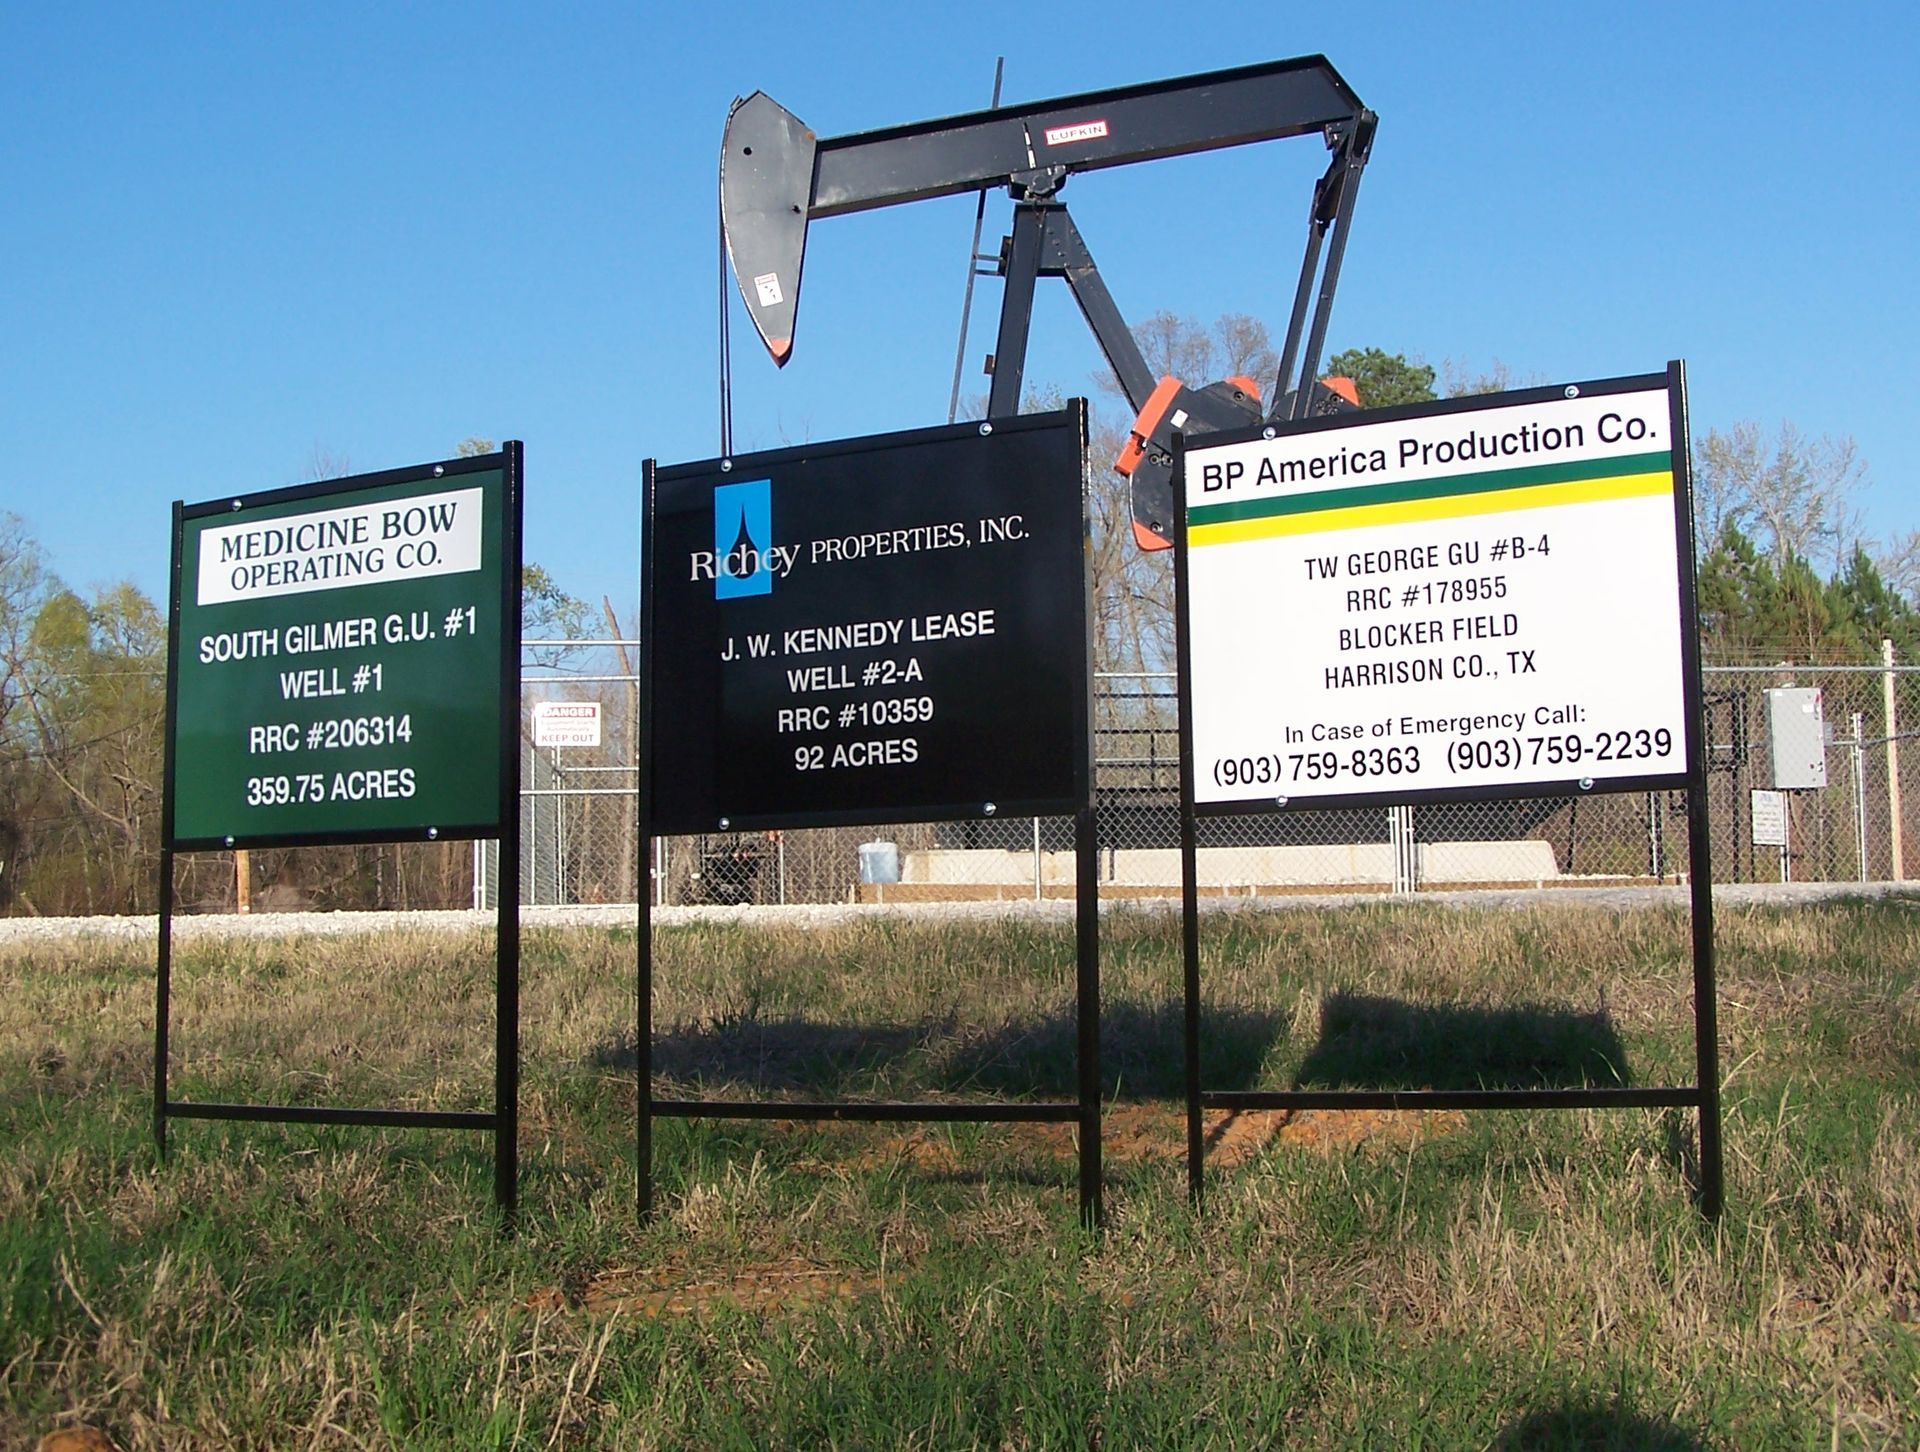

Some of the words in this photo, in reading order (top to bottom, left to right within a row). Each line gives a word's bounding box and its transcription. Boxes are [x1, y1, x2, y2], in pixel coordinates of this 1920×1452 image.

[1050, 126, 1102, 141] LUFKIN
[1203, 461, 1244, 493] BP
[1255, 446, 1387, 486] America
[1399, 422, 1584, 469] Production
[1597, 412, 1656, 444] Co.
[221, 516, 368, 562] MEDICINE
[382, 503, 457, 539] BOW
[690, 544, 801, 581] Richey
[812, 523, 970, 563] PROPERTIES,
[980, 516, 1029, 542] INC.
[232, 548, 383, 590] OPERATING
[397, 541, 441, 568] CO.
[1303, 555, 1339, 581] TW
[1347, 545, 1439, 577] GEORGE
[1448, 540, 1479, 566] GU
[1489, 533, 1550, 562] #B-4
[1347, 586, 1392, 613] RRC
[1401, 575, 1507, 608] #178955
[200, 629, 278, 663] SOUTH
[285, 618, 376, 653] GILMER
[384, 612, 435, 643] G.U.
[444, 607, 475, 637] #1
[722, 638, 739, 661] J.
[747, 634, 775, 657] W.
[785, 620, 903, 654] KENNEDY
[912, 610, 994, 641] LEASE
[1339, 620, 1444, 651] BLOCKER
[1453, 613, 1518, 641] FIELD
[281, 668, 346, 699] WELL
[353, 664, 381, 693] #1
[787, 665, 855, 692] WELL
[862, 658, 922, 685] #2-A
[1325, 657, 1443, 690] HARRISON
[1453, 654, 1498, 679] CO.,
[1506, 649, 1537, 674] TX
[543, 708, 594, 717] DANGER
[779, 706, 829, 732] RRC
[838, 697, 933, 727] #10359
[1285, 726, 1304, 744] In
[1311, 723, 1364, 742] Case
[1371, 718, 1392, 737] of
[1400, 712, 1526, 736] Emergency
[1534, 704, 1586, 726] Call:
[251, 724, 299, 753] RRC
[307, 715, 412, 749] #206314
[542, 734, 568, 742] KEEP
[572, 734, 594, 742] OUT
[795, 746, 824, 770] 92
[832, 738, 918, 767] ACRES
[248, 774, 324, 805] 359.75
[331, 768, 415, 800] ACRES
